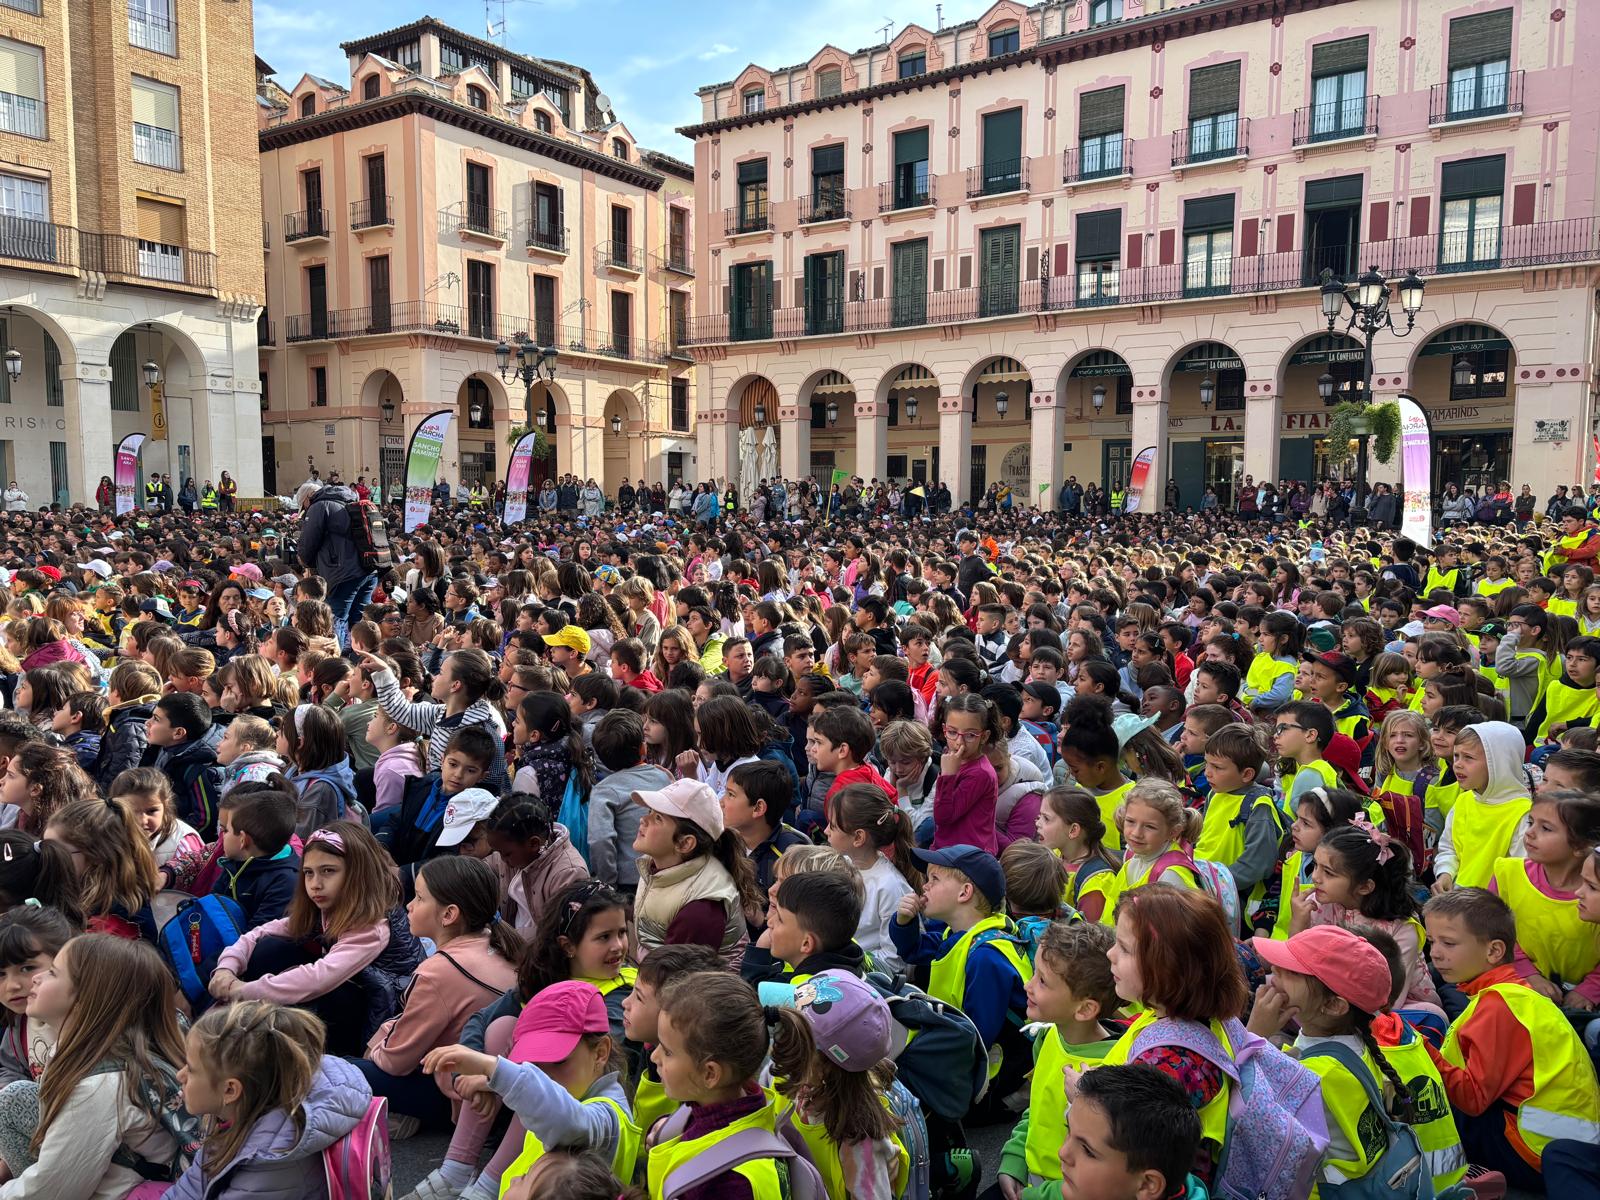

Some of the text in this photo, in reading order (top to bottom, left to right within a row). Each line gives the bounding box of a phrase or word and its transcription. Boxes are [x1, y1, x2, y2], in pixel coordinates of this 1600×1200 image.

[1328, 352, 1335, 362] LA
[1336, 352, 1364, 361] CONFIANZA
[1210, 361, 1216, 369] LA
[1217, 360, 1241, 369] CONFIANZA
[419, 429, 444, 439] MARCHA
[413, 441, 440, 453] SANCHO
